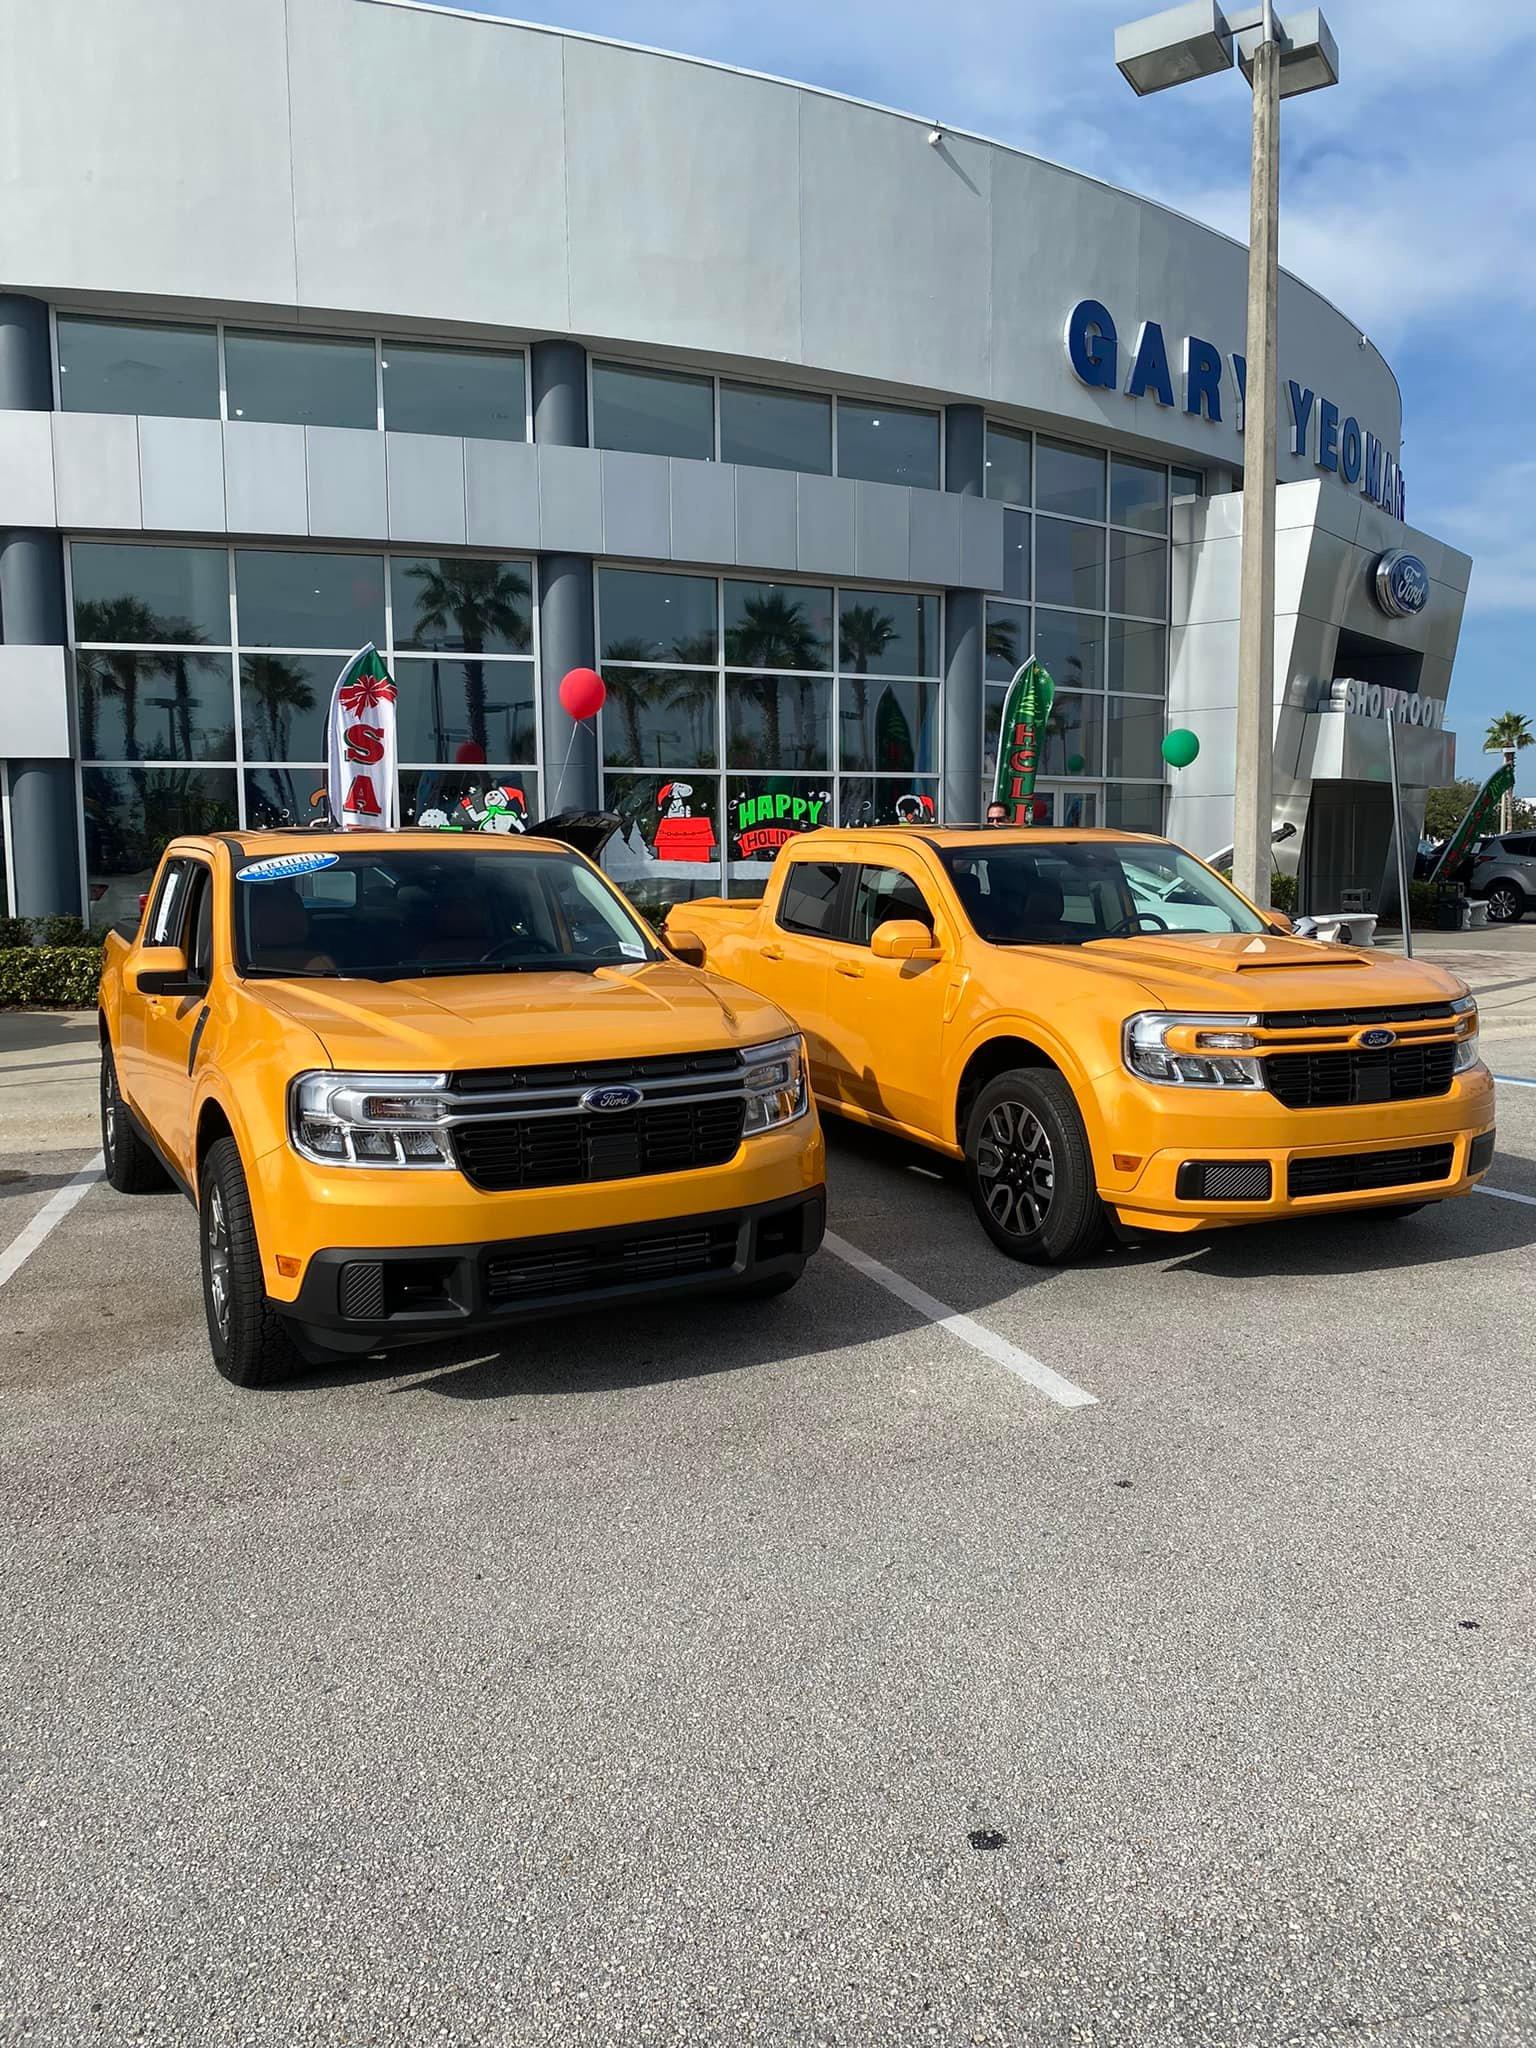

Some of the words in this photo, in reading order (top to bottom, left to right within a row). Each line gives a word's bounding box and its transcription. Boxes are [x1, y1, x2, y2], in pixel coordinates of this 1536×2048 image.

[1285, 380, 1406, 523] YEOMAN
[1397, 565, 1426, 605] Ford
[343, 724, 385, 831] SA
[738, 794, 823, 830] HAPPY
[246, 853, 326, 873] CERTIFIED
[1368, 1031, 1389, 1045] Ford
[600, 1092, 631, 1107] Ford
